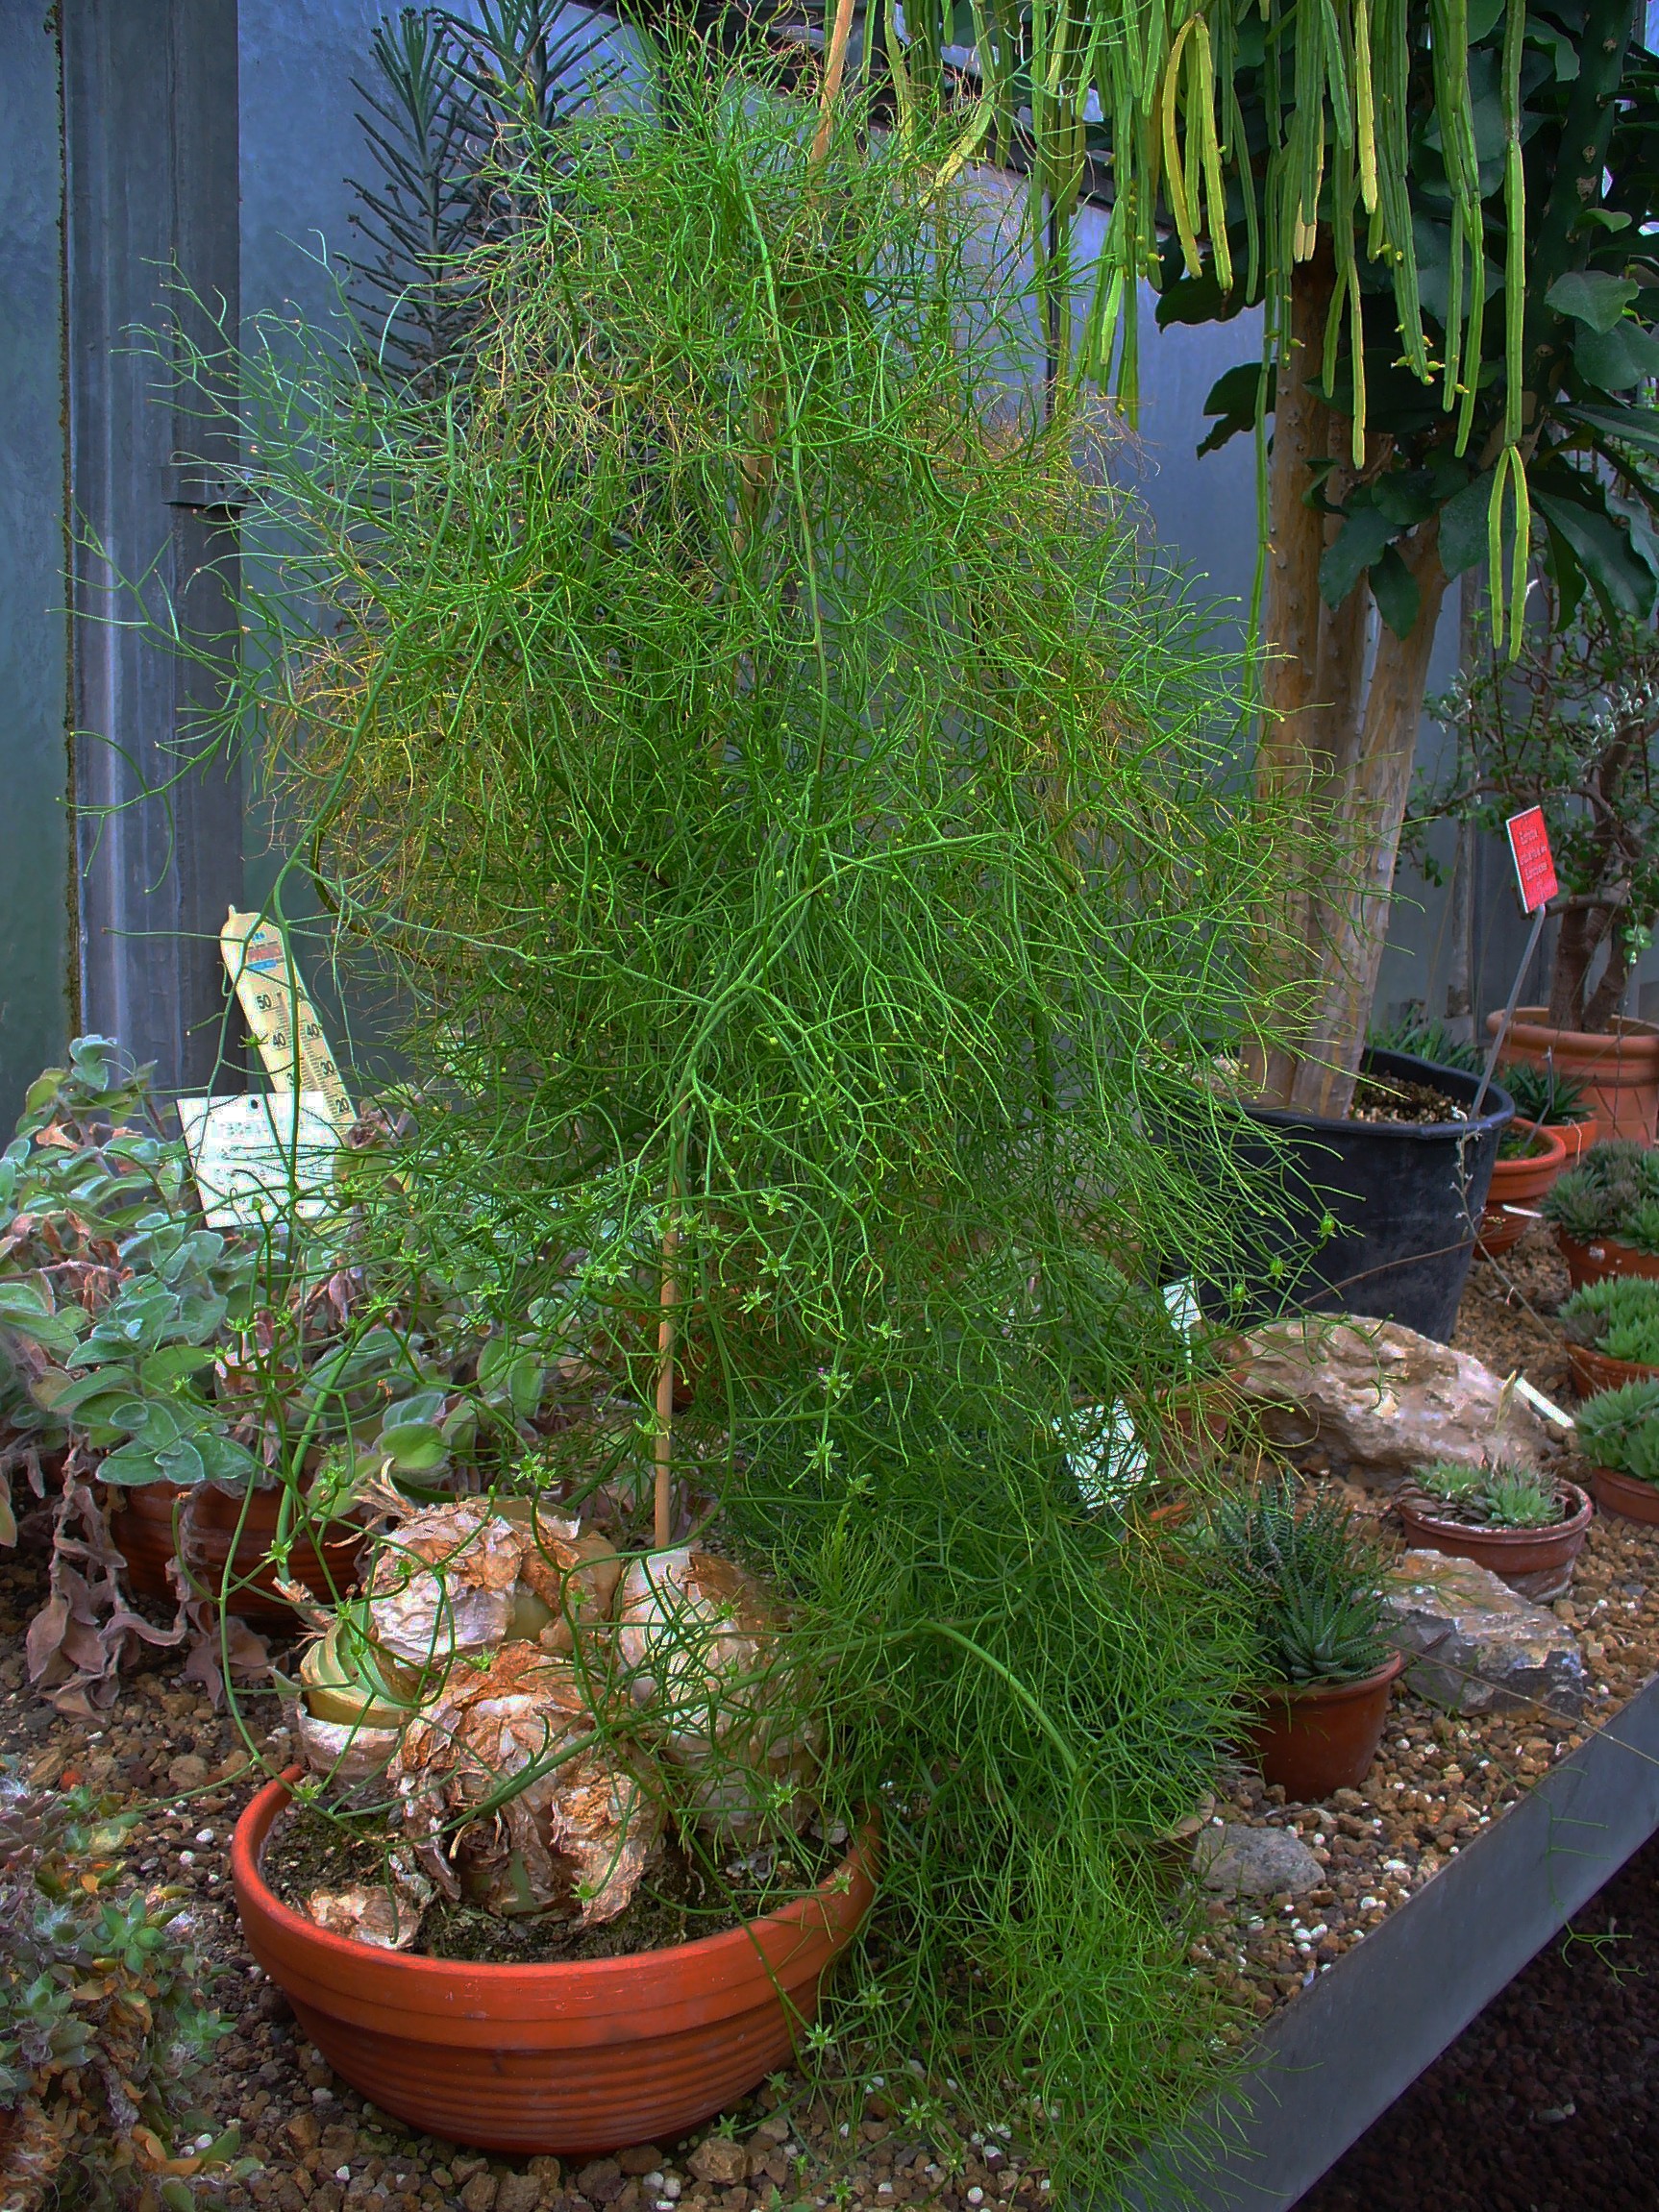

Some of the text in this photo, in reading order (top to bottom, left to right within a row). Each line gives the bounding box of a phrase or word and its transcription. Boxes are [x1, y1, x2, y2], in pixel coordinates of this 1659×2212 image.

[256, 994, 272, 1010] 50
[307, 1023, 320, 1037] 40
[272, 1032, 285, 1046] 40
[321, 1060, 335, 1075] 30
[335, 1097, 350, 1113] 20
